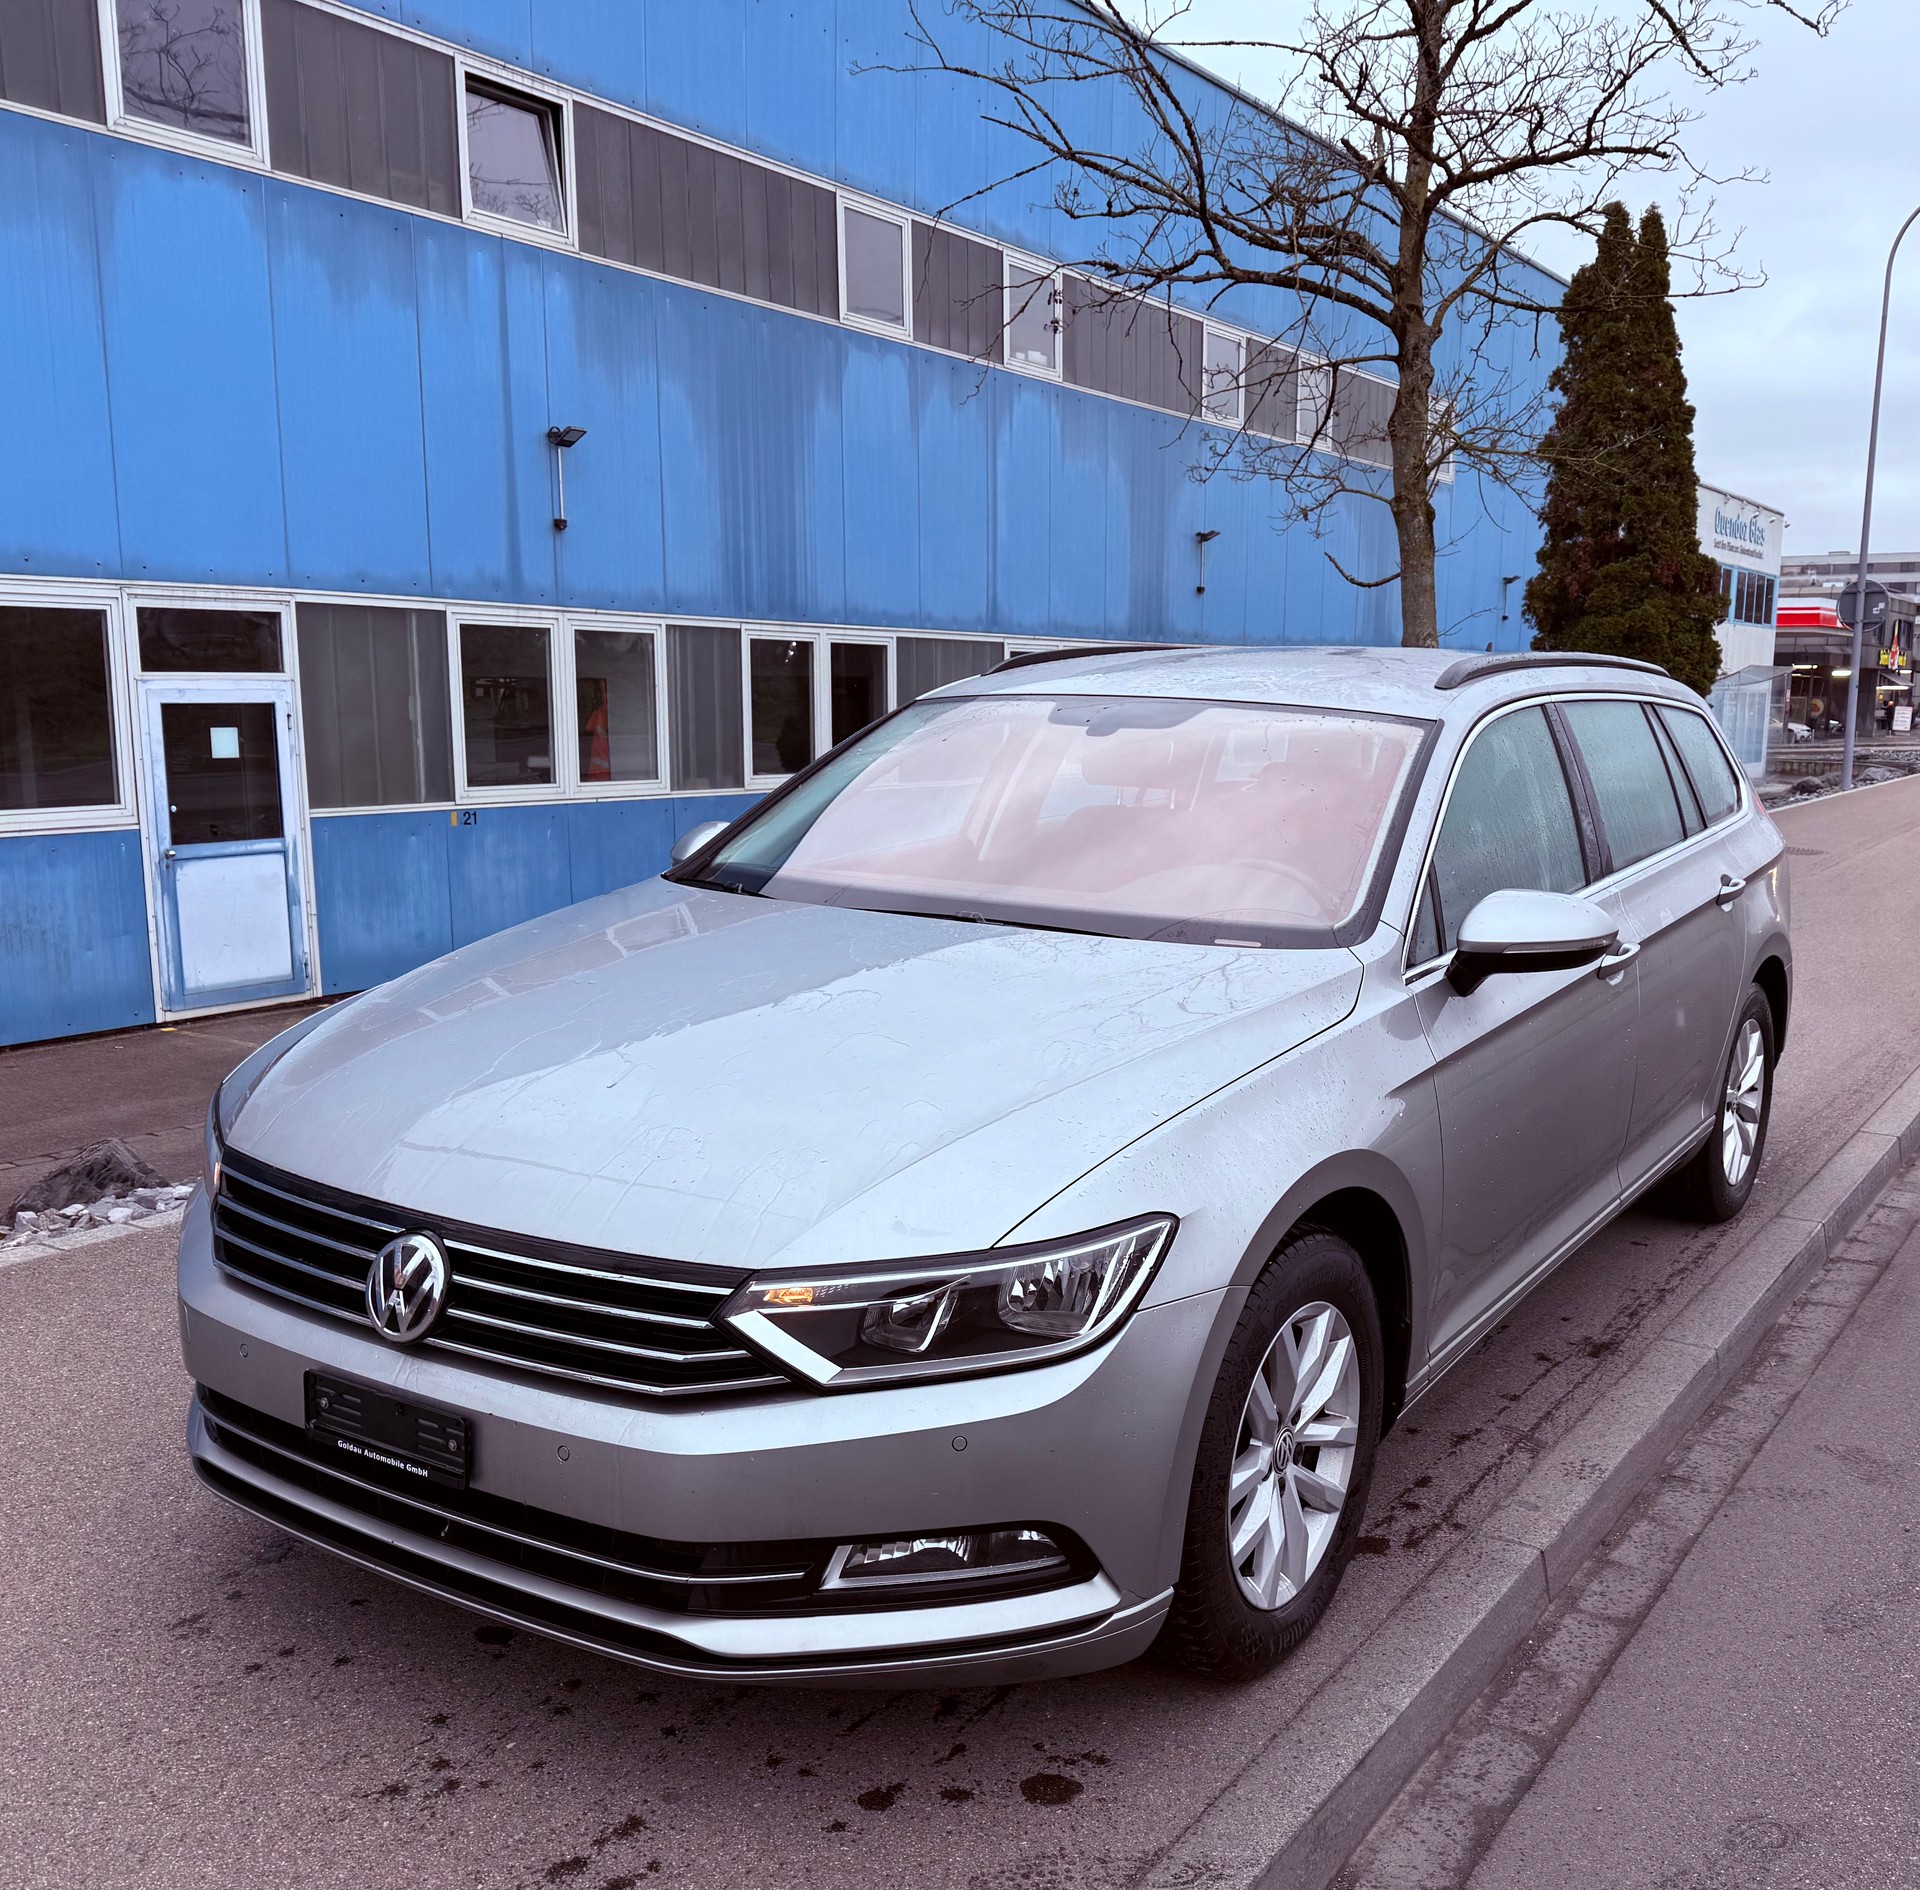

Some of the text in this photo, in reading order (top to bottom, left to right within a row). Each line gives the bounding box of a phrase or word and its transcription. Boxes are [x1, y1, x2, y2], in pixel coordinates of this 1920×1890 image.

[463, 811, 477, 825] 21
[337, 1440, 428, 1477] Goldau Automobile GmbH
